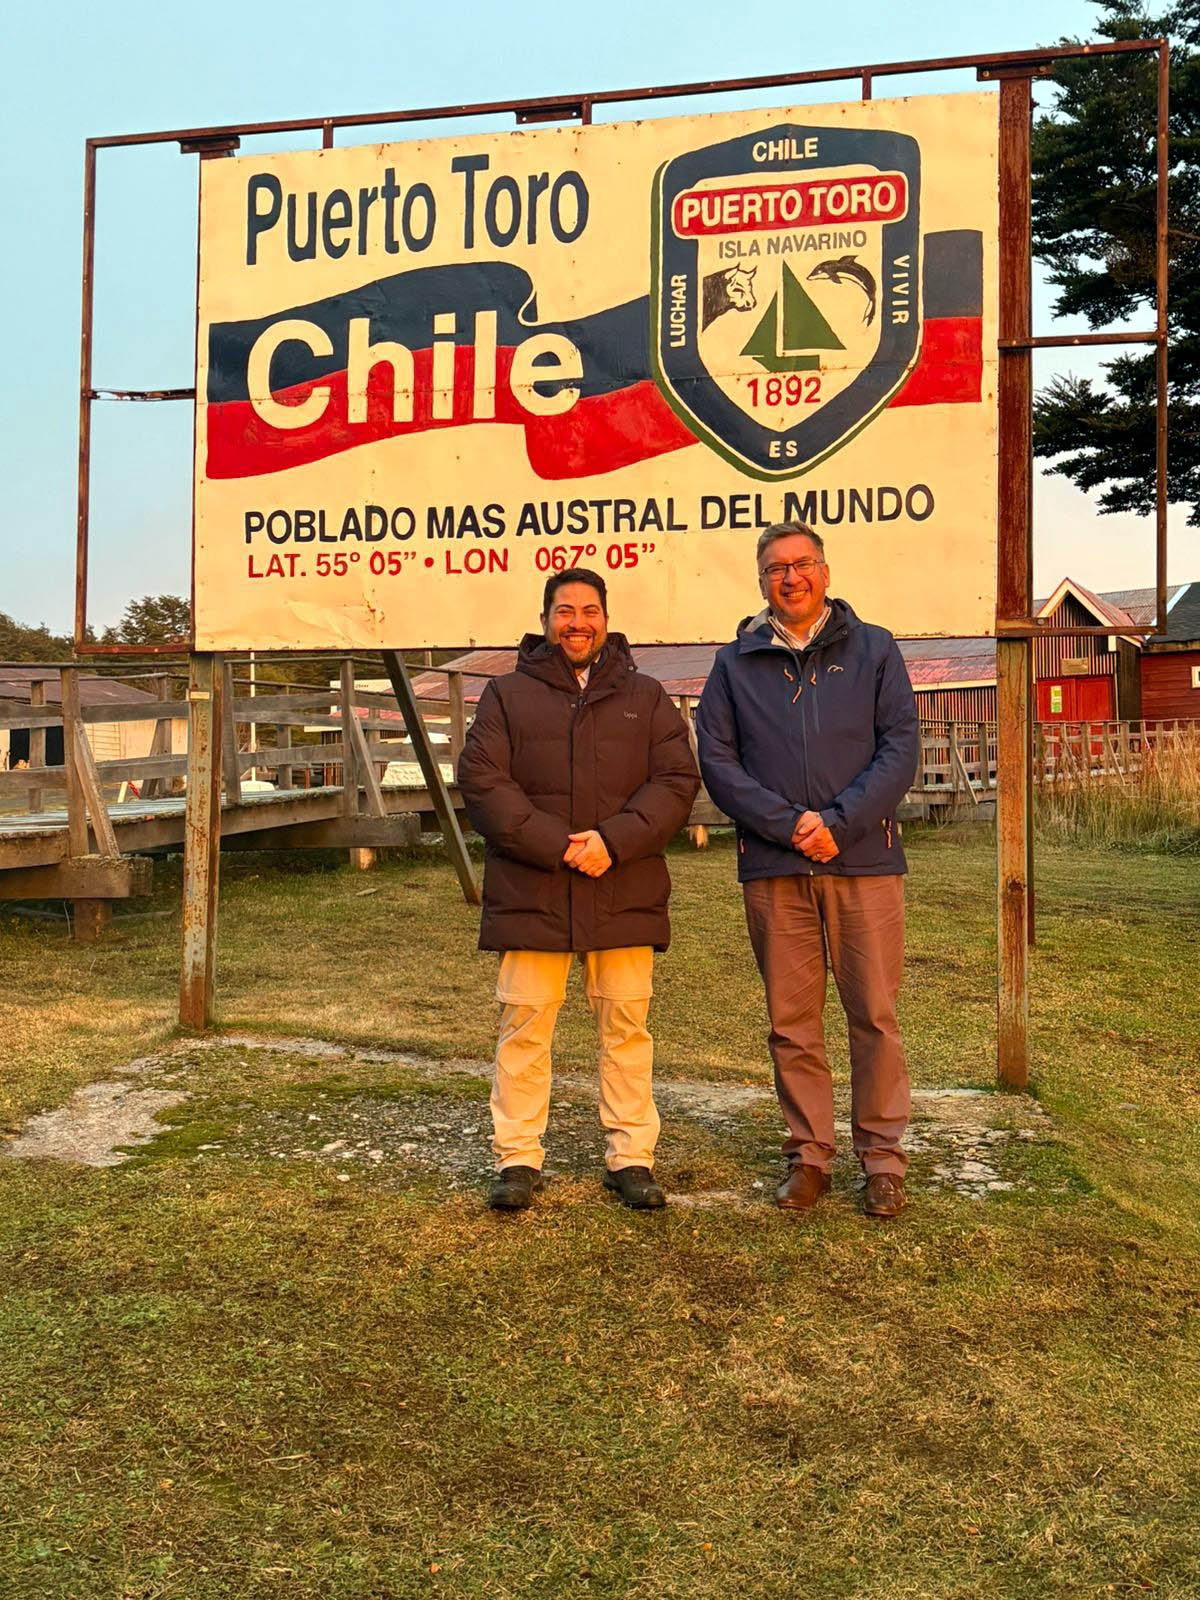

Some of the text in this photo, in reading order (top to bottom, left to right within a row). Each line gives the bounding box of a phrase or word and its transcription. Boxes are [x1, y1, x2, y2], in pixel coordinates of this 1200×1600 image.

[752, 137, 818, 162] CHILE
[246, 154, 589, 265] Puerto Toro
[681, 181, 897, 228] PUERTO TORO
[719, 229, 867, 259] ISLA NAVARINO
[670, 274, 687, 347] LUCHAR
[892, 254, 910, 325] VIVIR
[247, 310, 583, 429] Chile
[746, 377, 821, 407] 1892
[244, 484, 935, 544] POBLADO MAS AUSTRAL DEL MUNDO
[248, 553, 307, 578] LAT.
[316, 551, 360, 577] 55°
[445, 548, 509, 575] LON
[535, 543, 597, 571] 067°
